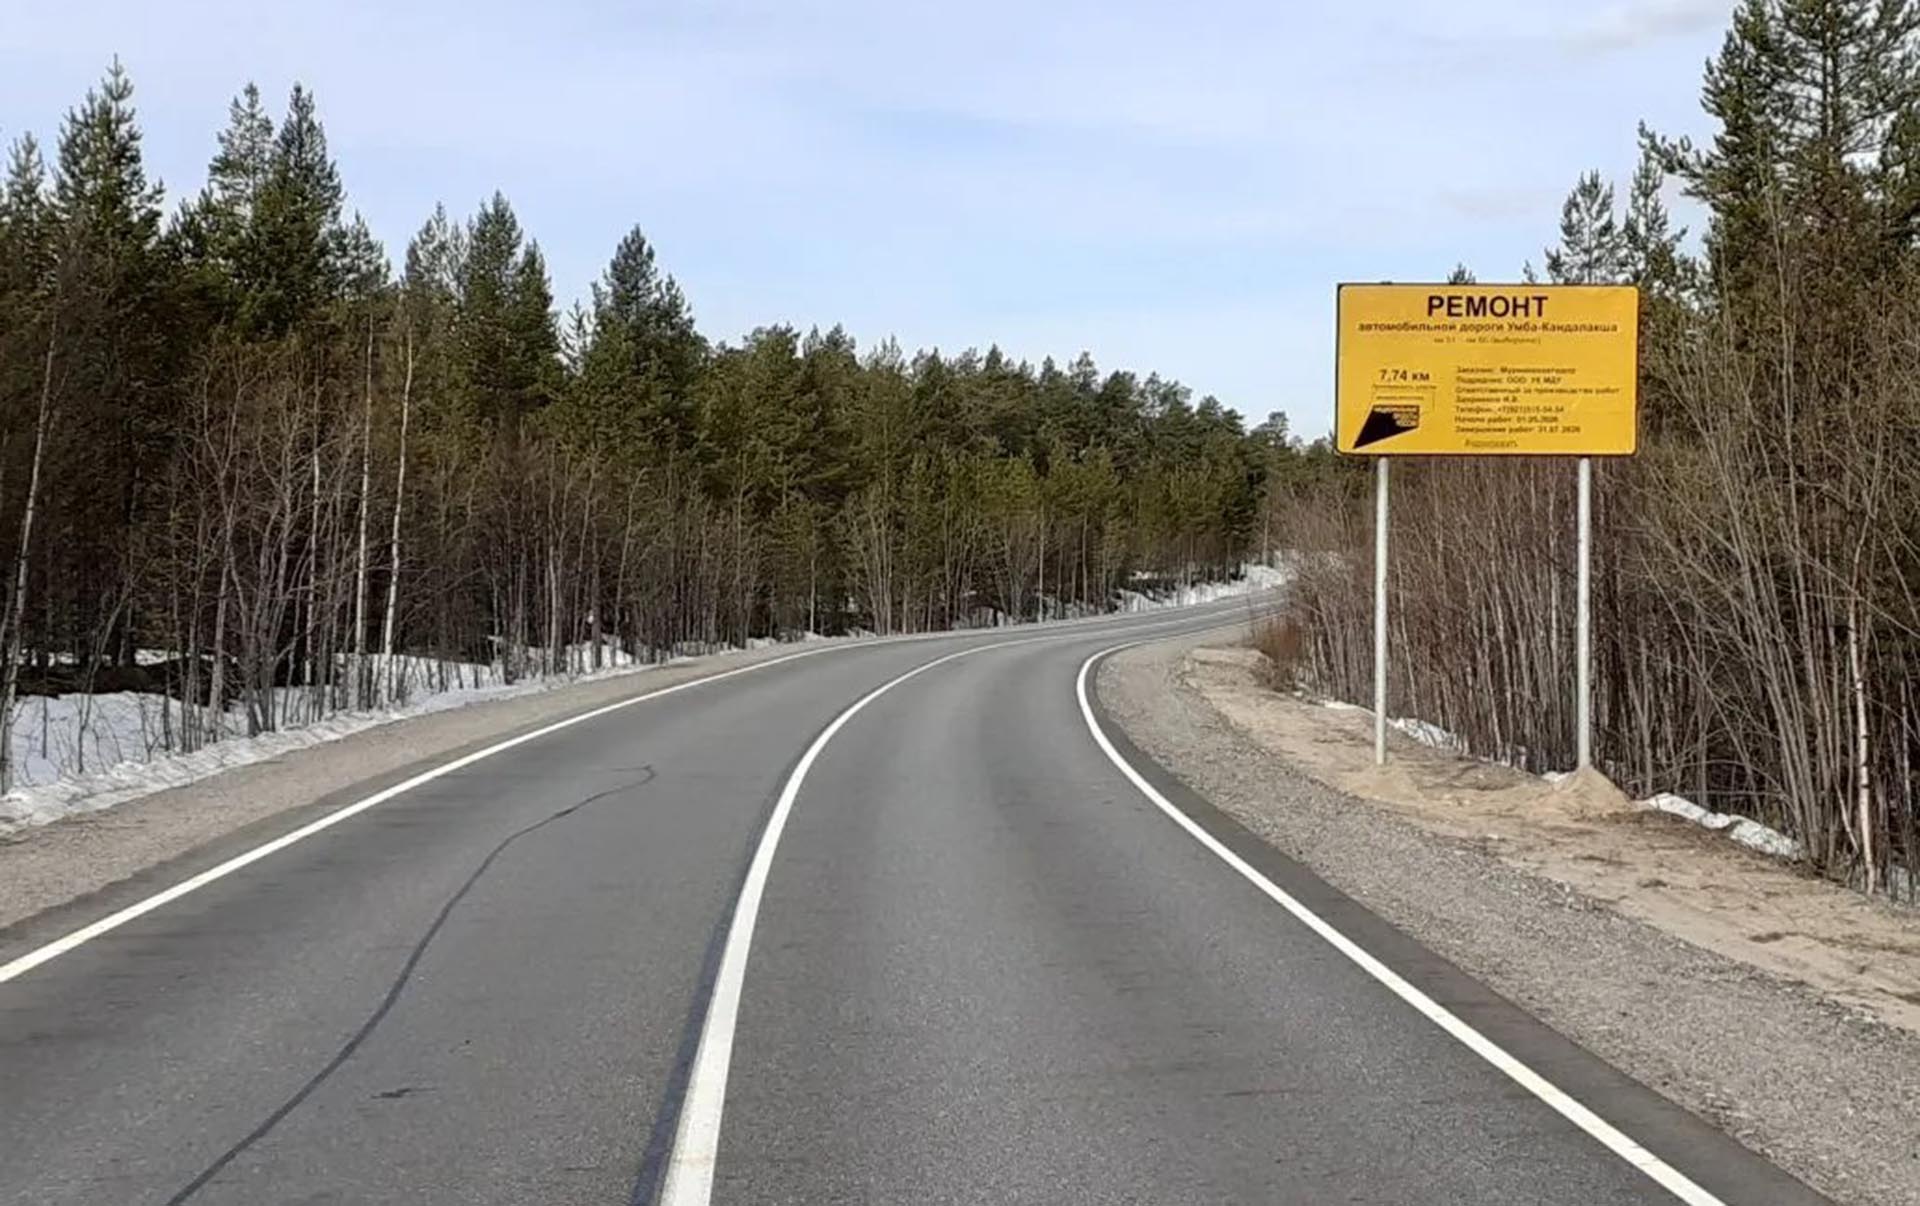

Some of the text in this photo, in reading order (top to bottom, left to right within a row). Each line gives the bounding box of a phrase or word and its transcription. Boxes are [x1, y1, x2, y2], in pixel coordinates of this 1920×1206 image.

[1427, 296, 1548, 317] РЕМОНТ
[1358, 322, 1618, 334] автомобильной дороги Умба-Кандалакша
[1379, 369, 1430, 381] 7,74 км
